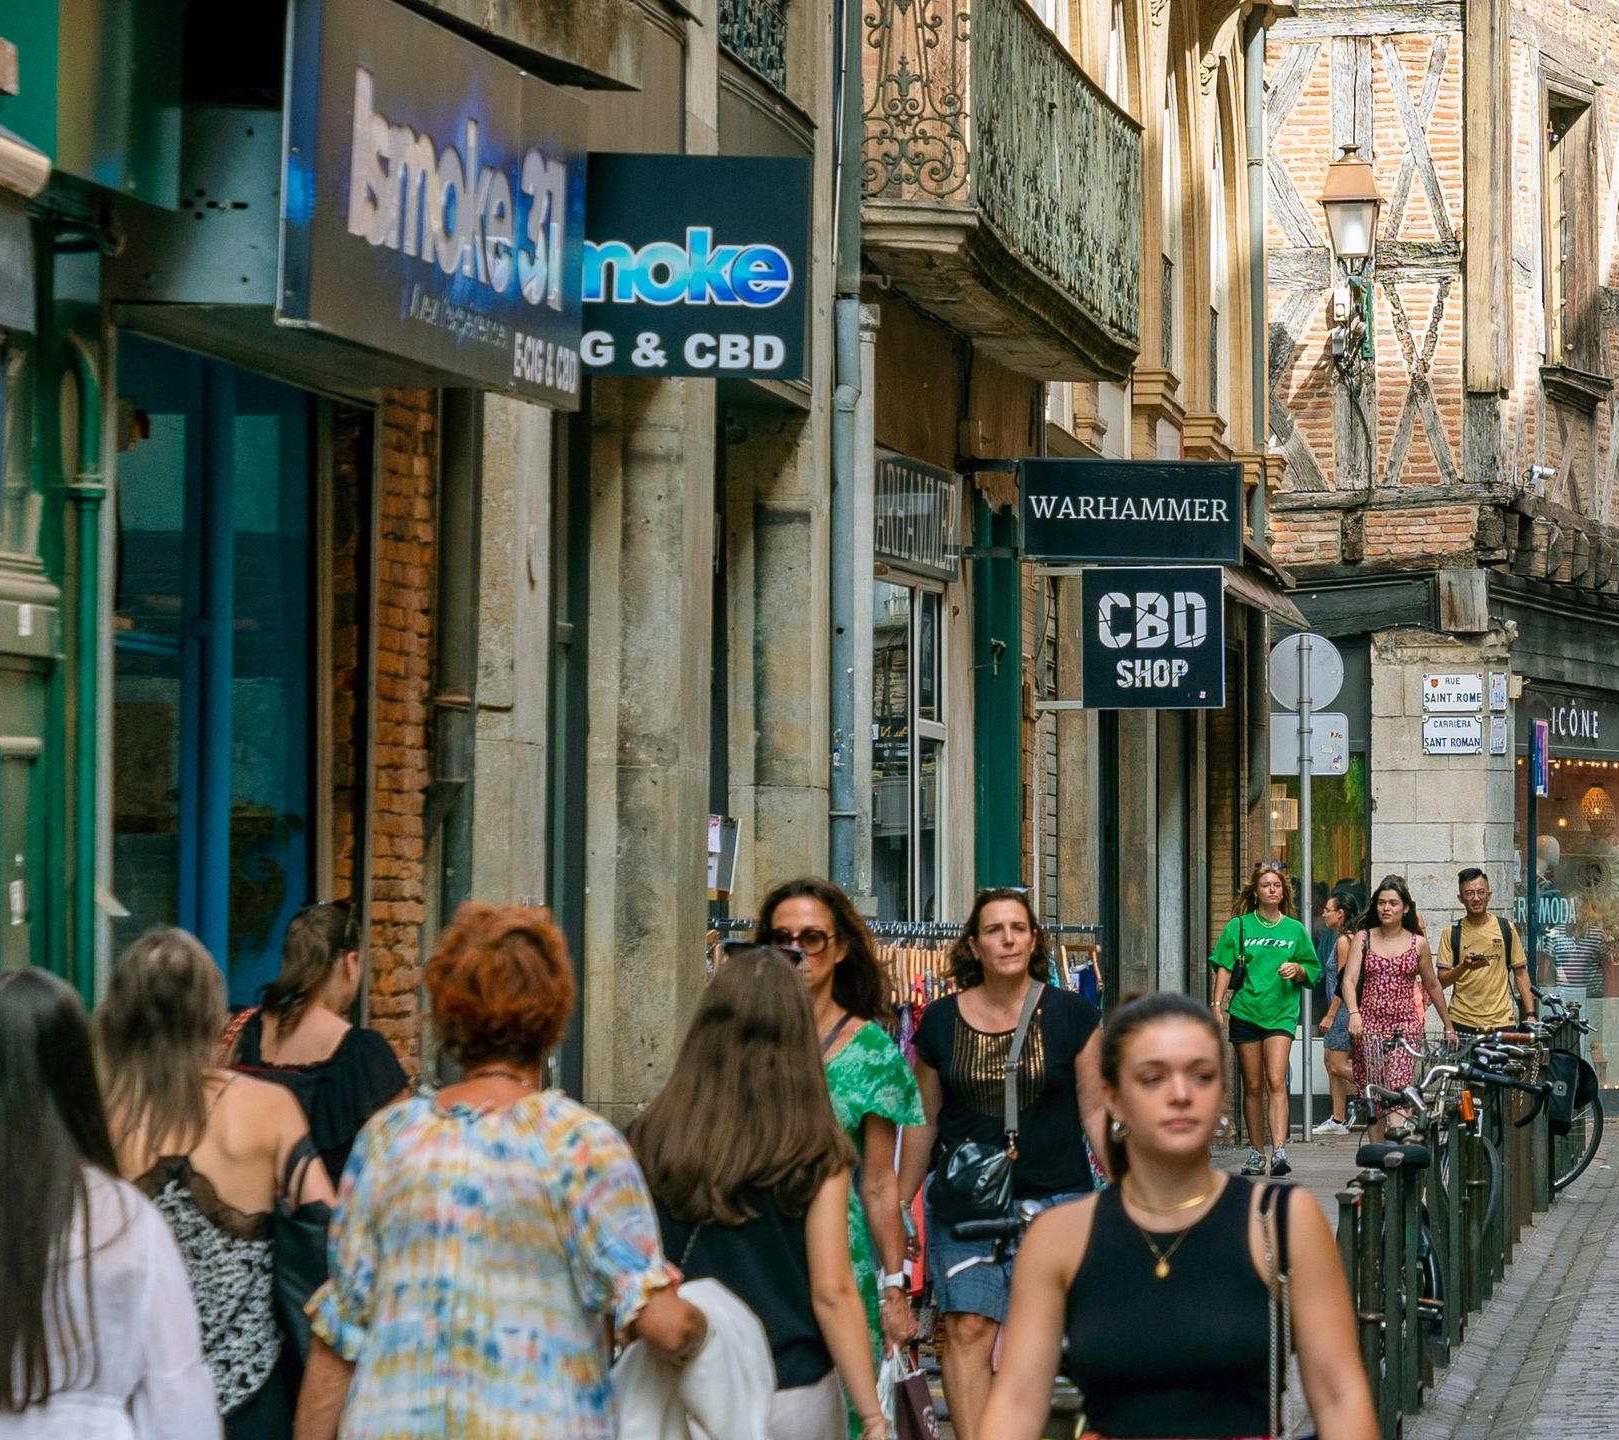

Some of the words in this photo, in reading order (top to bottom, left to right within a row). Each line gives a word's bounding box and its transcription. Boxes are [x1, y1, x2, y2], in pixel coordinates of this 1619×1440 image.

[630, 331, 669, 369] &
[683, 332, 787, 371] CBD
[555, 345, 579, 395] CBD
[1028, 493, 1230, 523] WARHAMMER
[1097, 591, 1209, 649] CBD
[1115, 657, 1189, 689] SHOP
[1444, 676, 1461, 686] RUE
[1551, 698, 1600, 739] ICÔNE
[1424, 736, 1447, 748] SANT
[1450, 736, 1481, 748] ROMAN
[1538, 896, 1578, 925] MODA
